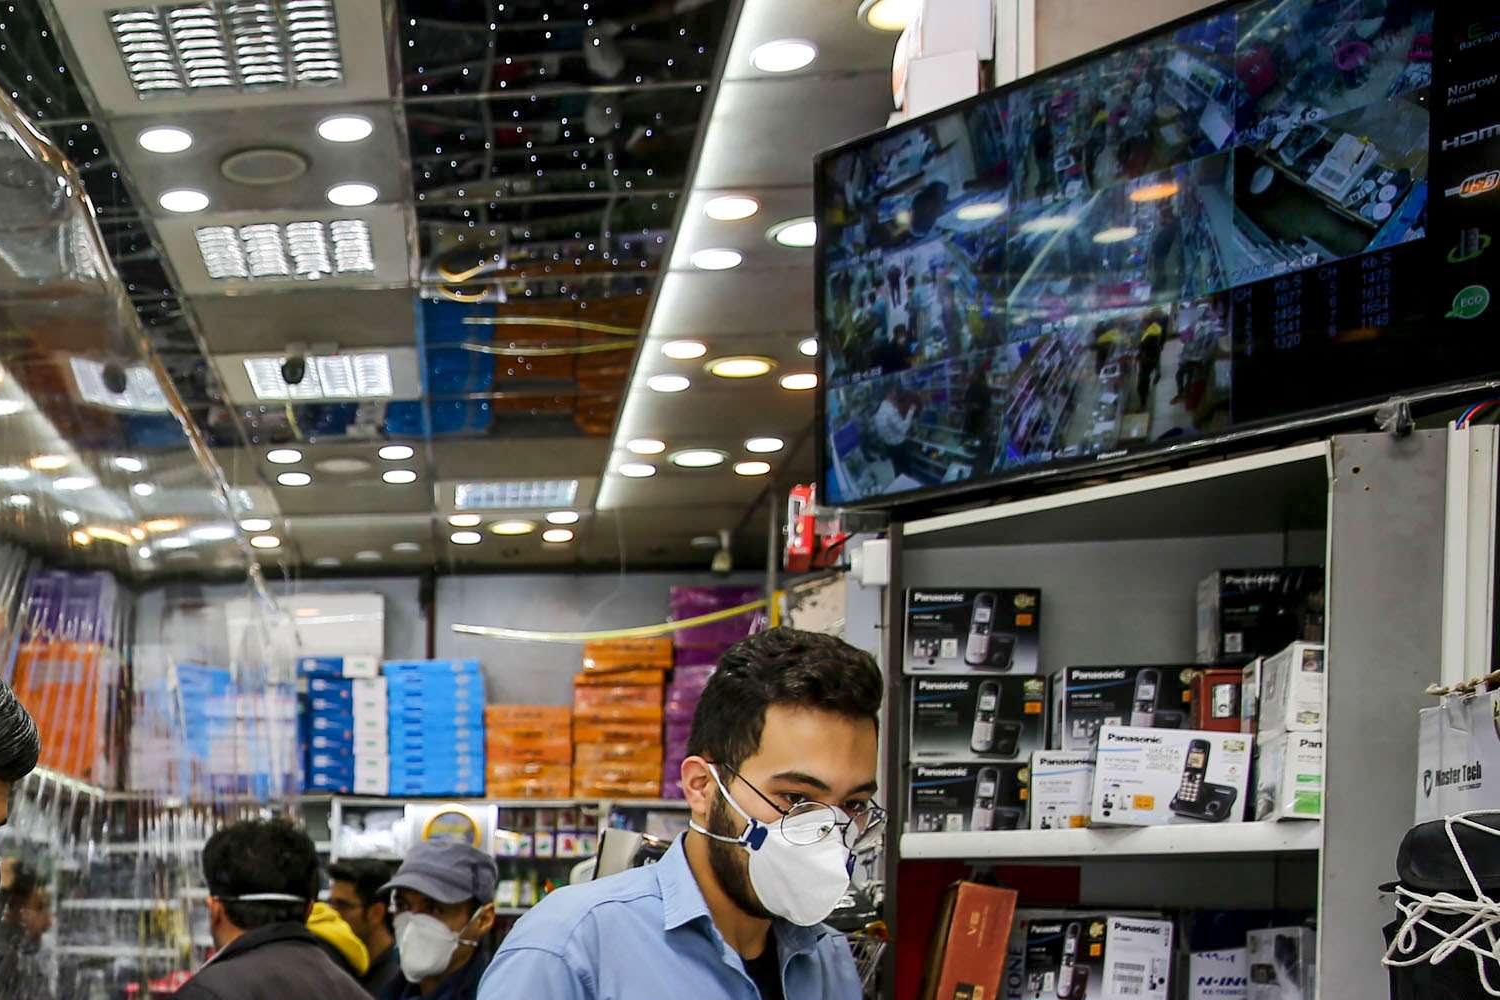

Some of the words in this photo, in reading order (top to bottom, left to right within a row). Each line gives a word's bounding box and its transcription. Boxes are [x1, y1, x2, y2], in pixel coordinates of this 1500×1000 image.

[914, 592, 965, 603] Panasonic
[1071, 669, 1127, 681] Panasonic
[918, 680, 970, 692] Panasonic
[1107, 732, 1163, 745] Panasonic
[917, 766, 968, 778] Panasonic
[1434, 769, 1461, 788] Master
[1462, 761, 1482, 783] Tech
[1113, 922, 1162, 936] Panasonic
